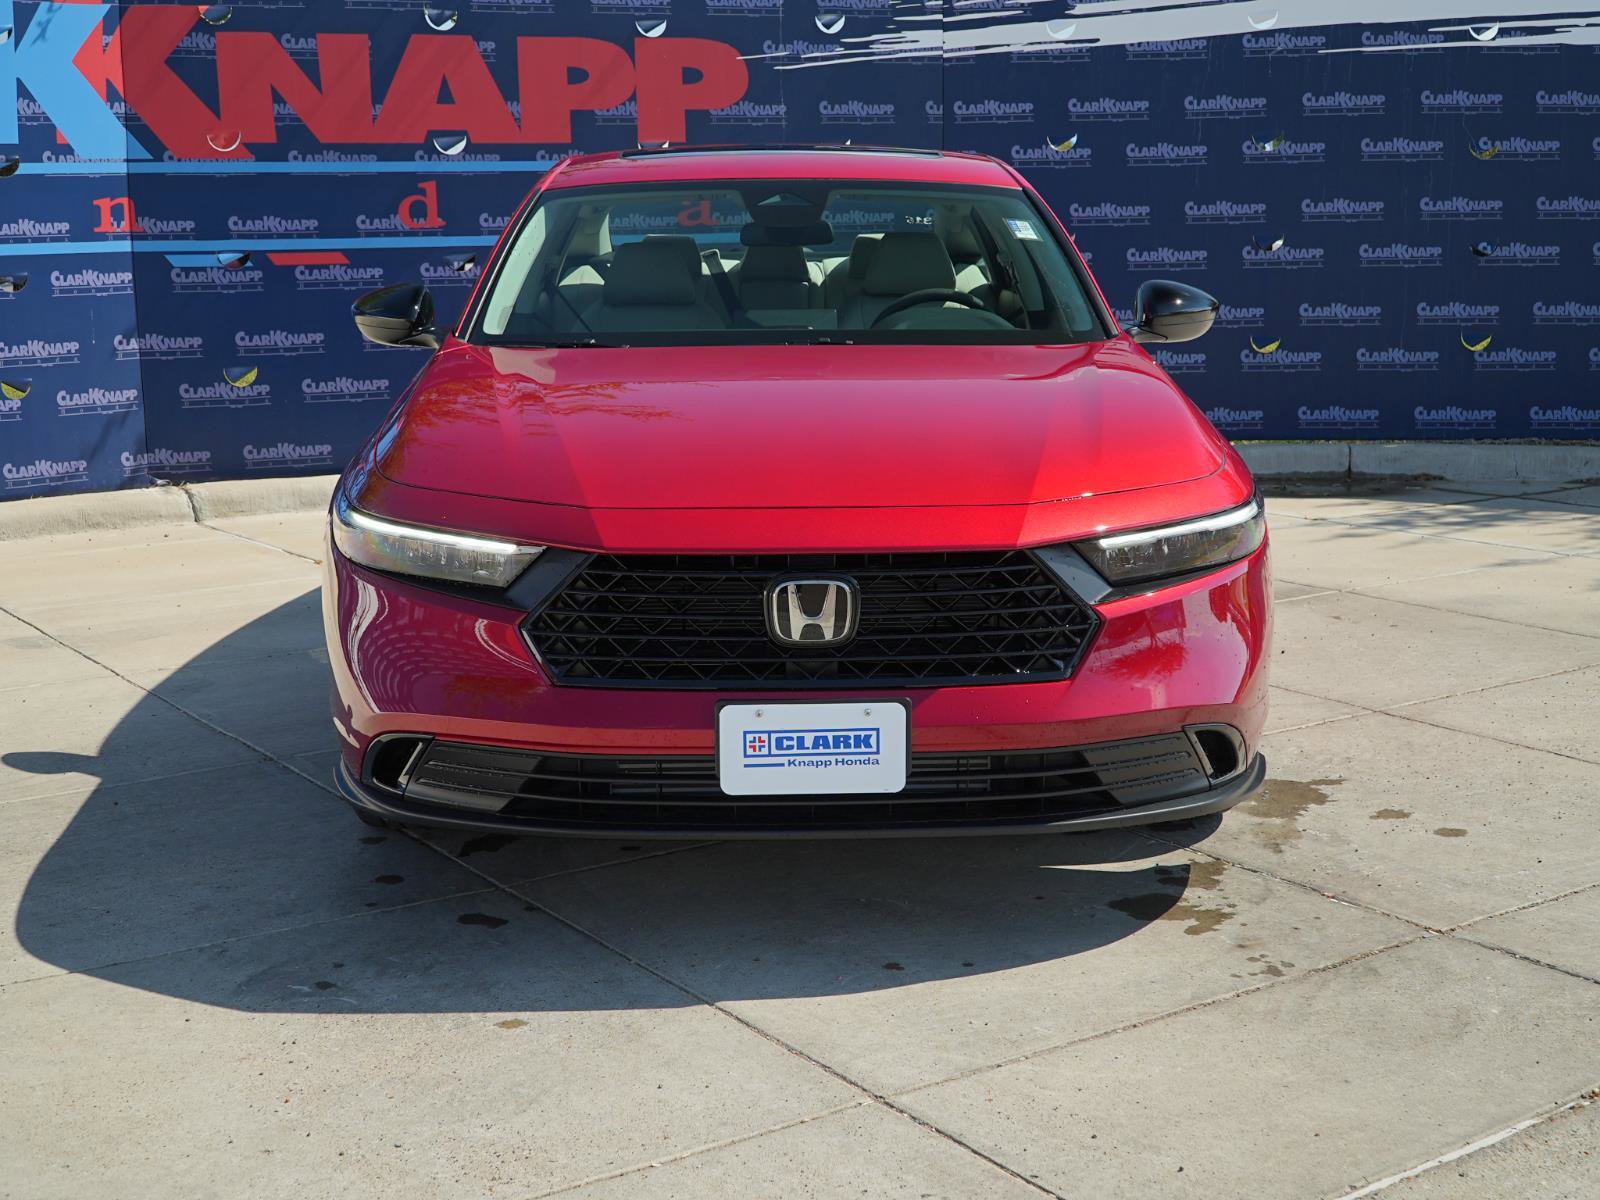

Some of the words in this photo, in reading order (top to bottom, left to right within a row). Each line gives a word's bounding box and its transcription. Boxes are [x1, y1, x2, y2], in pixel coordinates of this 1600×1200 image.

[774, 734, 874, 752] CLARK
[787, 757, 833, 769] Knapp
[835, 756, 881, 768] Honda
